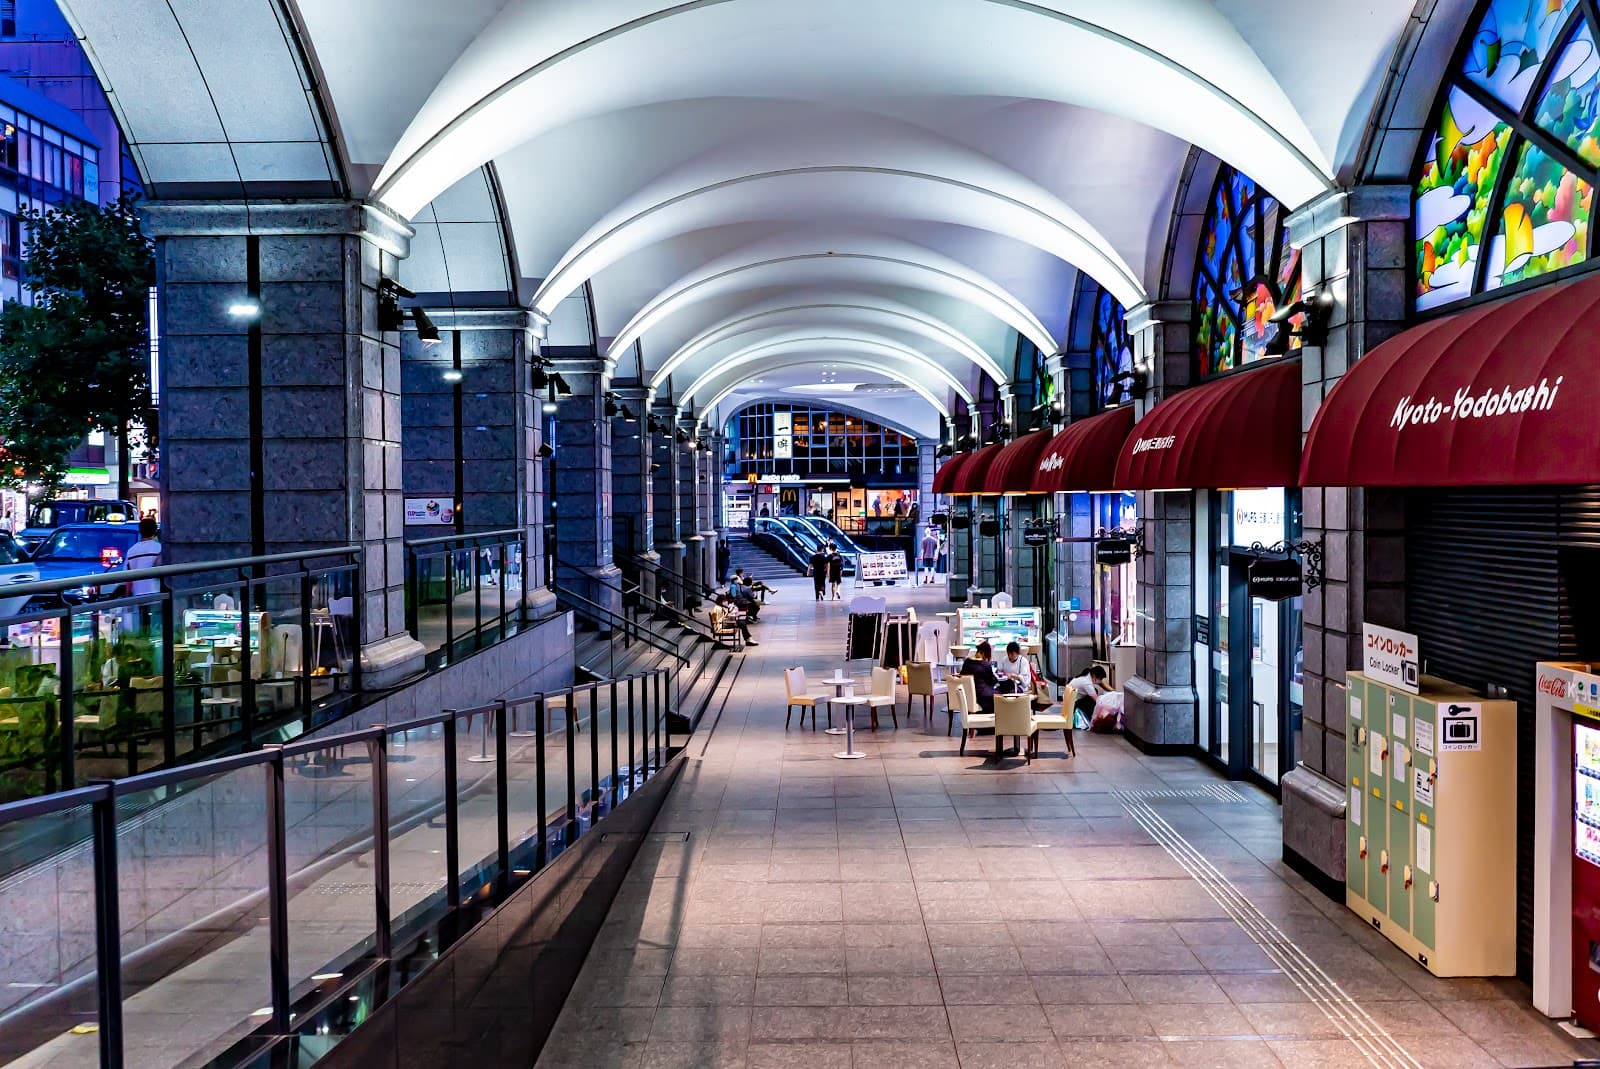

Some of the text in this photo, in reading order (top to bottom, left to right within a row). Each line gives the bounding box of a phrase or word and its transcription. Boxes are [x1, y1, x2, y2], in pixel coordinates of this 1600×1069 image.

[1389, 375, 1563, 431] Kyoto-Yodobashi
[1367, 633, 1413, 657] コインロッカー
[1369, 656, 1400, 676] Coin Locker
